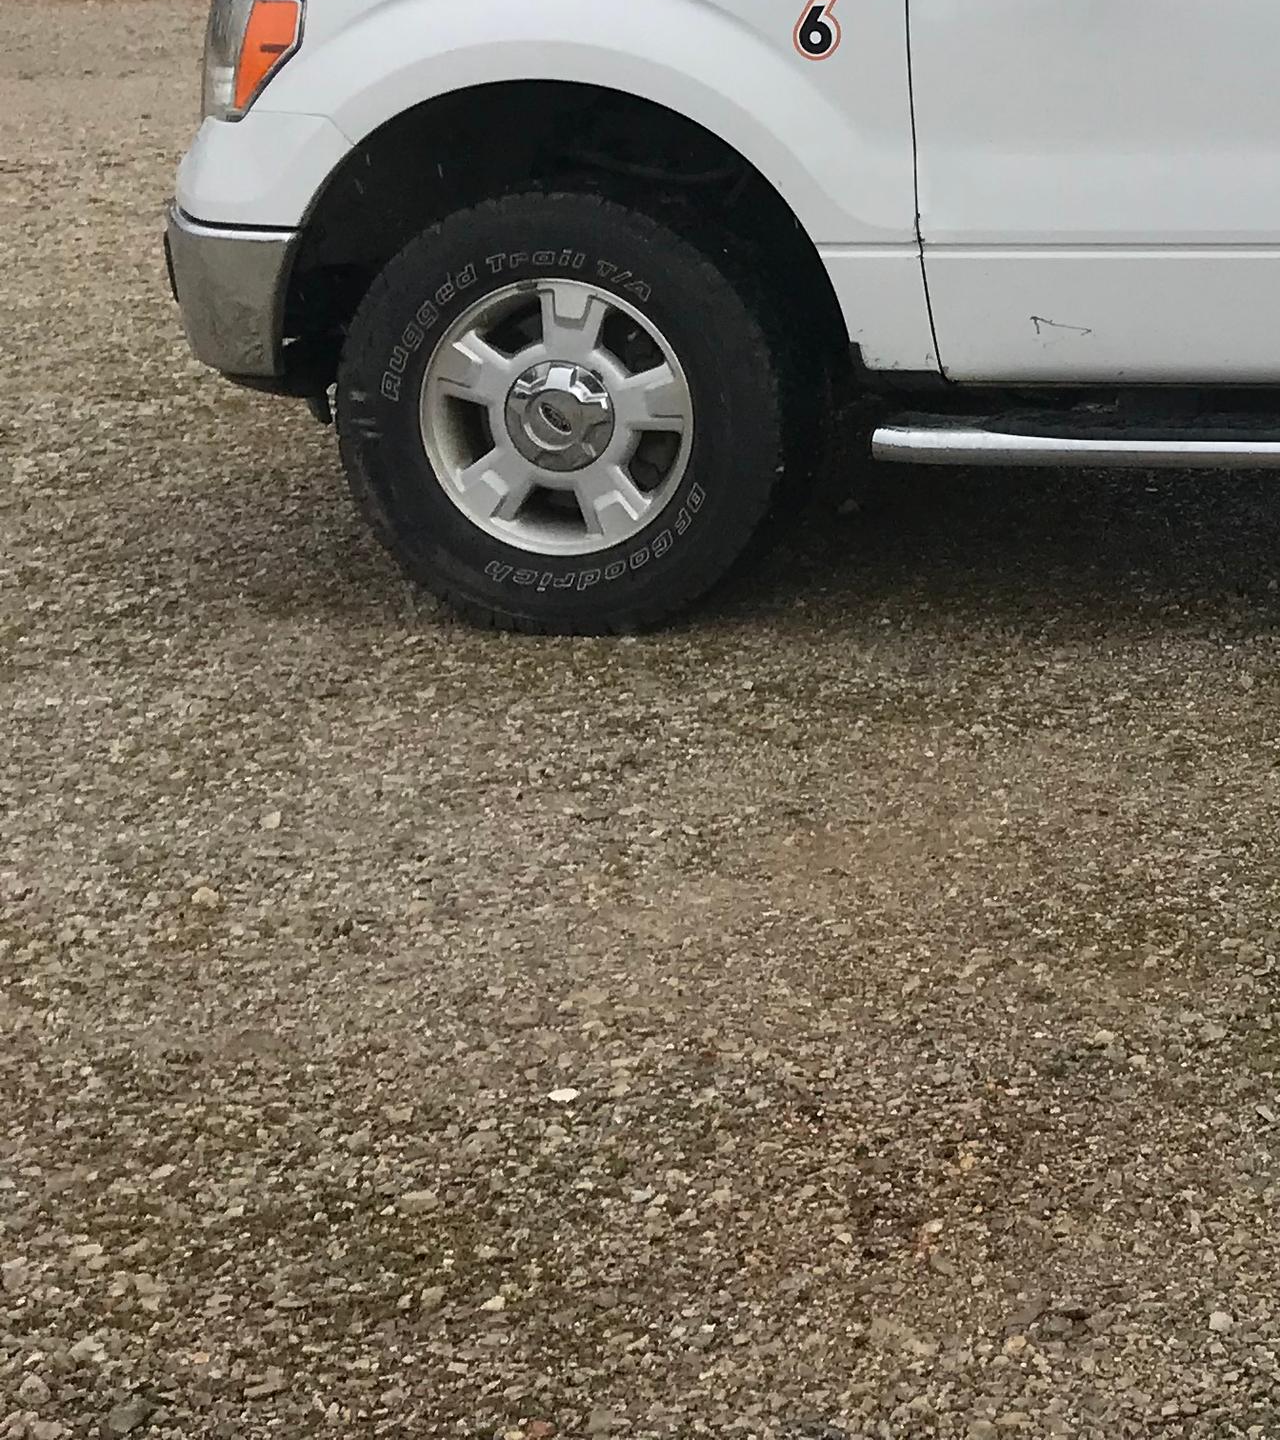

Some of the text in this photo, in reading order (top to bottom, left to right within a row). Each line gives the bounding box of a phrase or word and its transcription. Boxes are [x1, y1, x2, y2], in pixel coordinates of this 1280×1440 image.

[380, 249, 652, 403] Rugged Trail T/A
[483, 482, 707, 592] BFGoodrich
